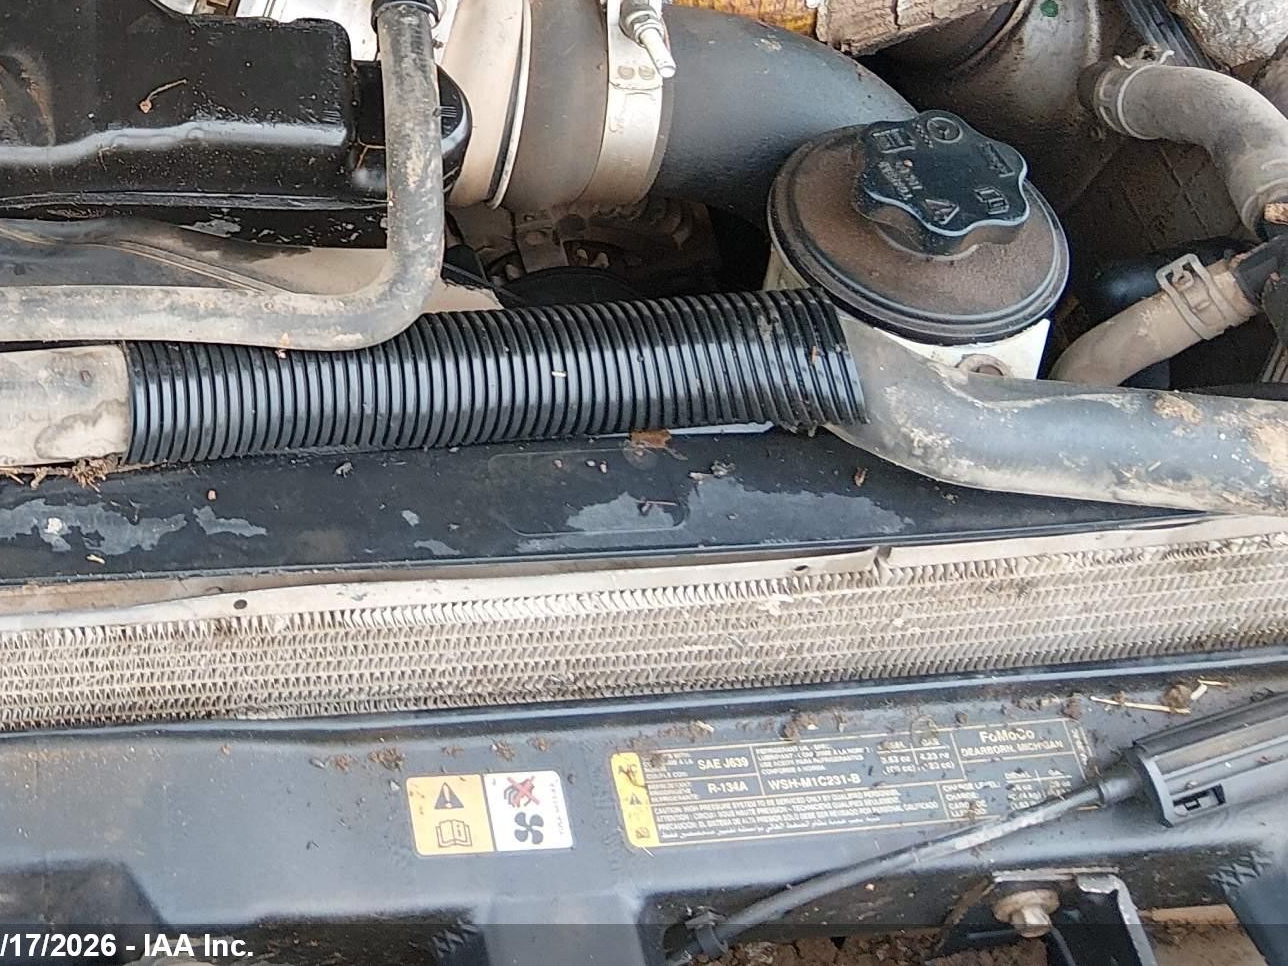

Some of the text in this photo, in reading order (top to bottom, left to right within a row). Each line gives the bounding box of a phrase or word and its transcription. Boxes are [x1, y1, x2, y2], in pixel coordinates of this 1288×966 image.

[979, 729, 1035, 744] FoMoCo
[697, 756, 749, 771] SAE J639
[707, 781, 749, 794] R-134A
[768, 773, 862, 790] WSH-M1C231-B
